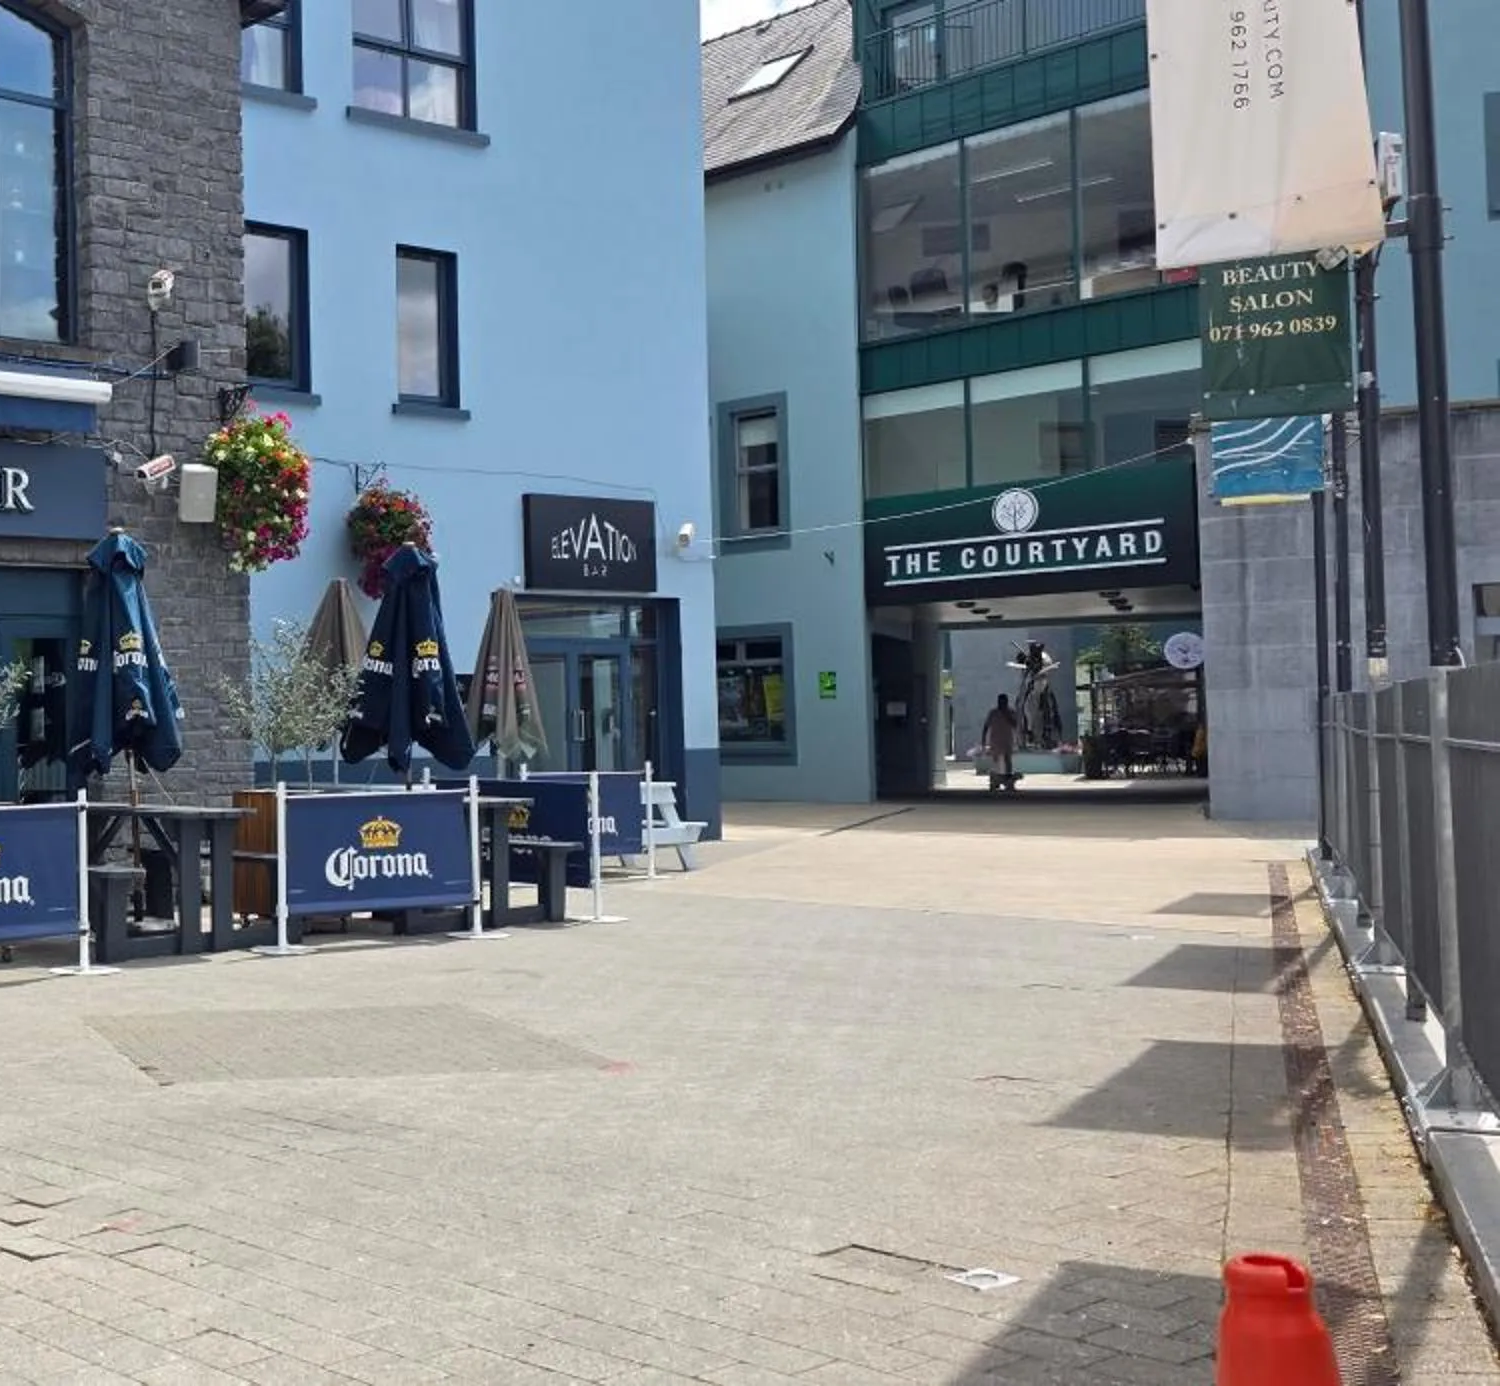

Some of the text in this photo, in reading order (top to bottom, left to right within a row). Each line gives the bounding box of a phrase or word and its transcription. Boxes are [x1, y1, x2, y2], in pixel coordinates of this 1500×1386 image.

[1230, 11, 1250, 109] 962 1766
[1222, 261, 1318, 286] BEAUTY
[1229, 288, 1313, 313] SALON
[1209, 315, 1337, 342] 071 962 0839
[886, 530, 1163, 576] THE COURTYARD
[325, 846, 430, 890] Corona
